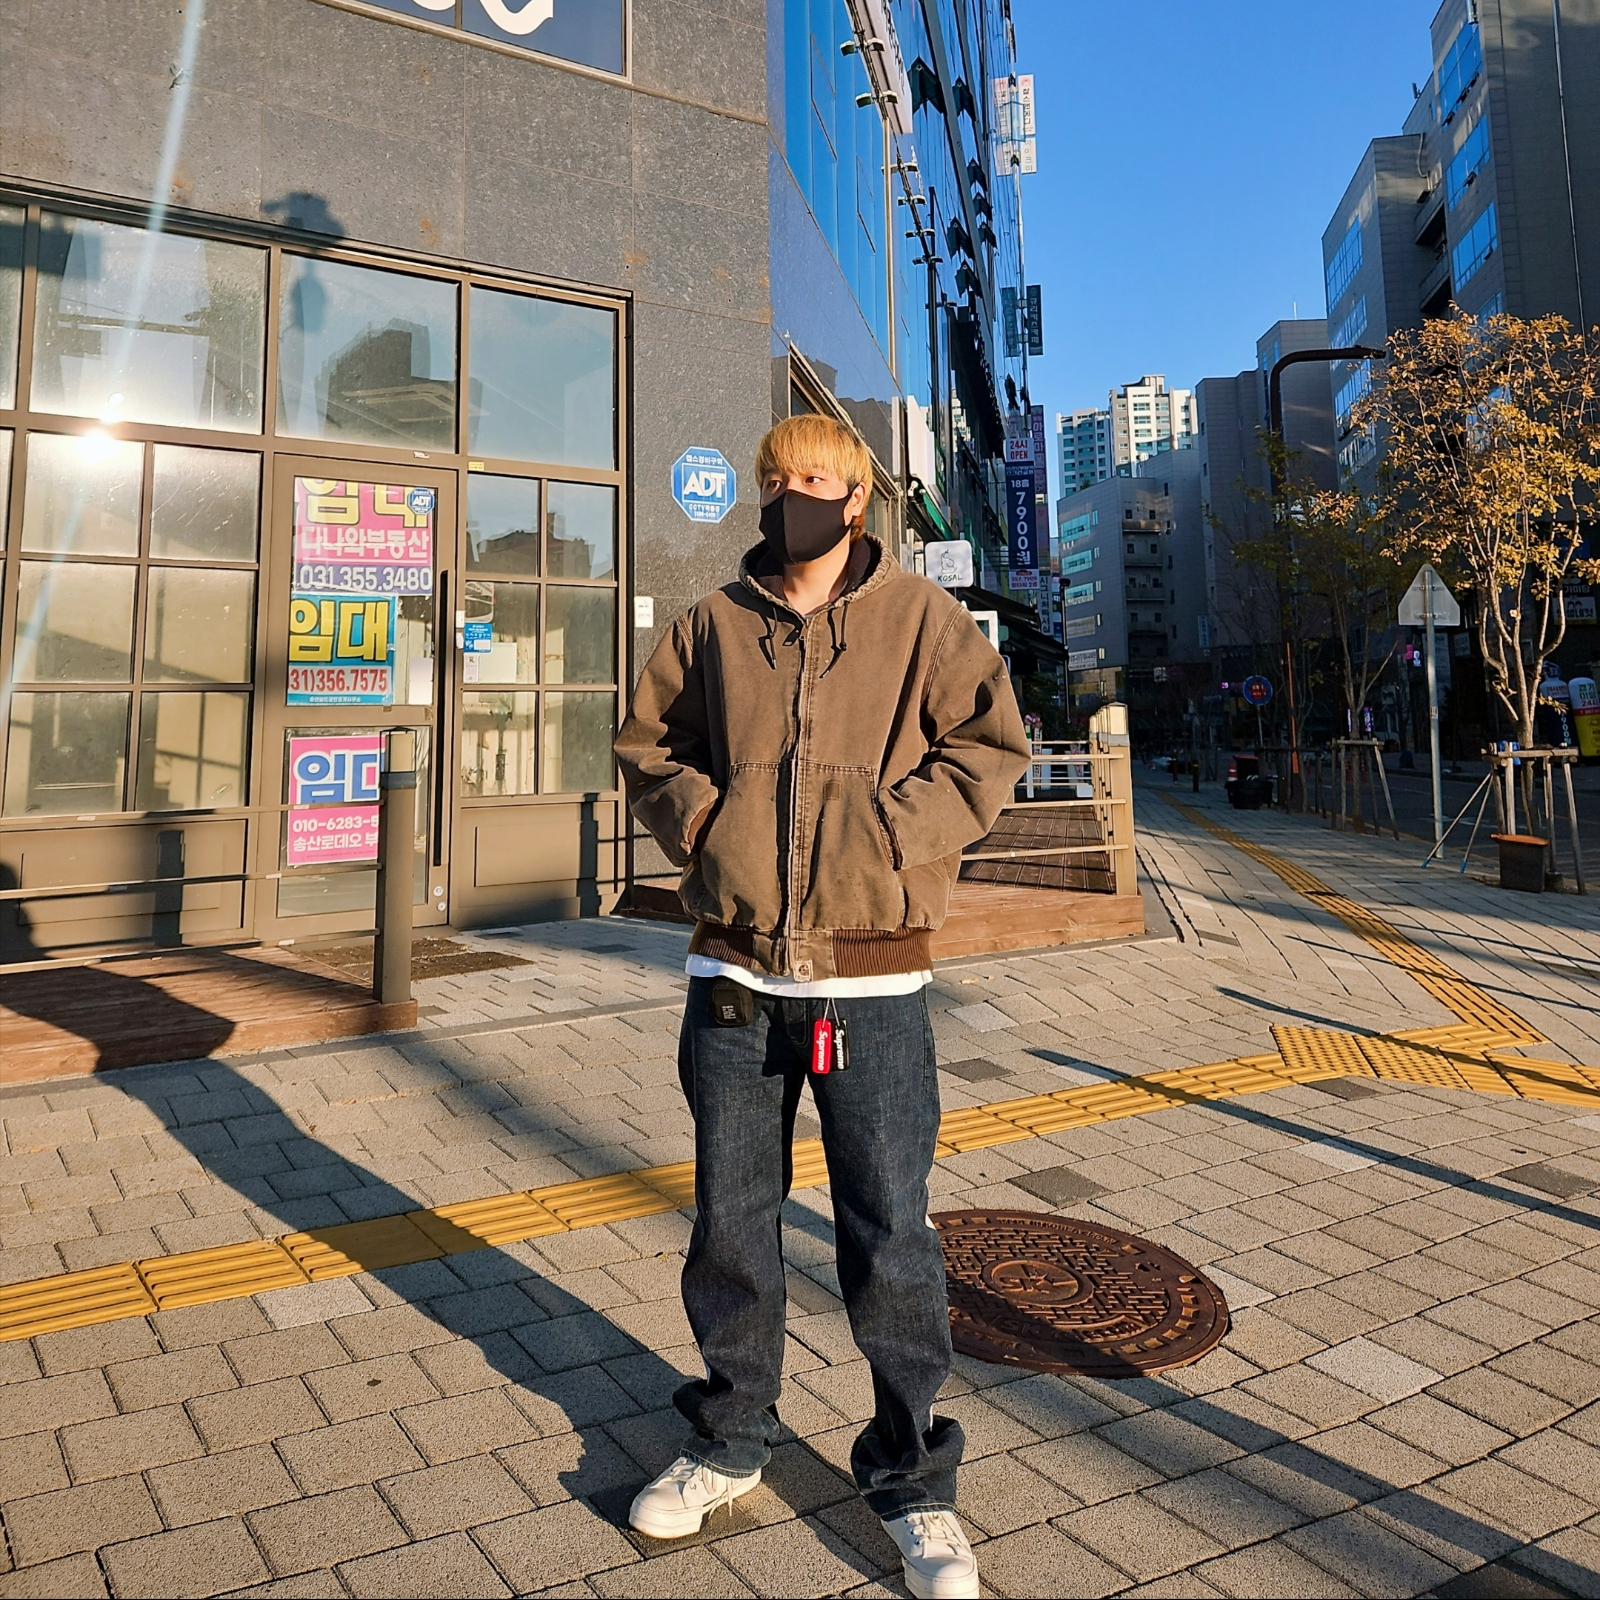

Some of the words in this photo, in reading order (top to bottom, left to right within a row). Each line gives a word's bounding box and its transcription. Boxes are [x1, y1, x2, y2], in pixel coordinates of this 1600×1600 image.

[1010, 441, 1028, 450] 24시
[1010, 451, 1028, 460] OPEN
[683, 470, 726, 499] ADT
[412, 495, 431, 507] ADT
[1016, 491, 1031, 565] 7900원
[301, 526, 430, 560] 다나와부동산
[299, 565, 433, 591] 031355.3480
[937, 574, 963, 582] KOSAL
[289, 598, 390, 663] 임대
[293, 832, 363, 852] 송산로데오
[816, 1030, 828, 1072] Supreme
[834, 1028, 845, 1070] Supreme
